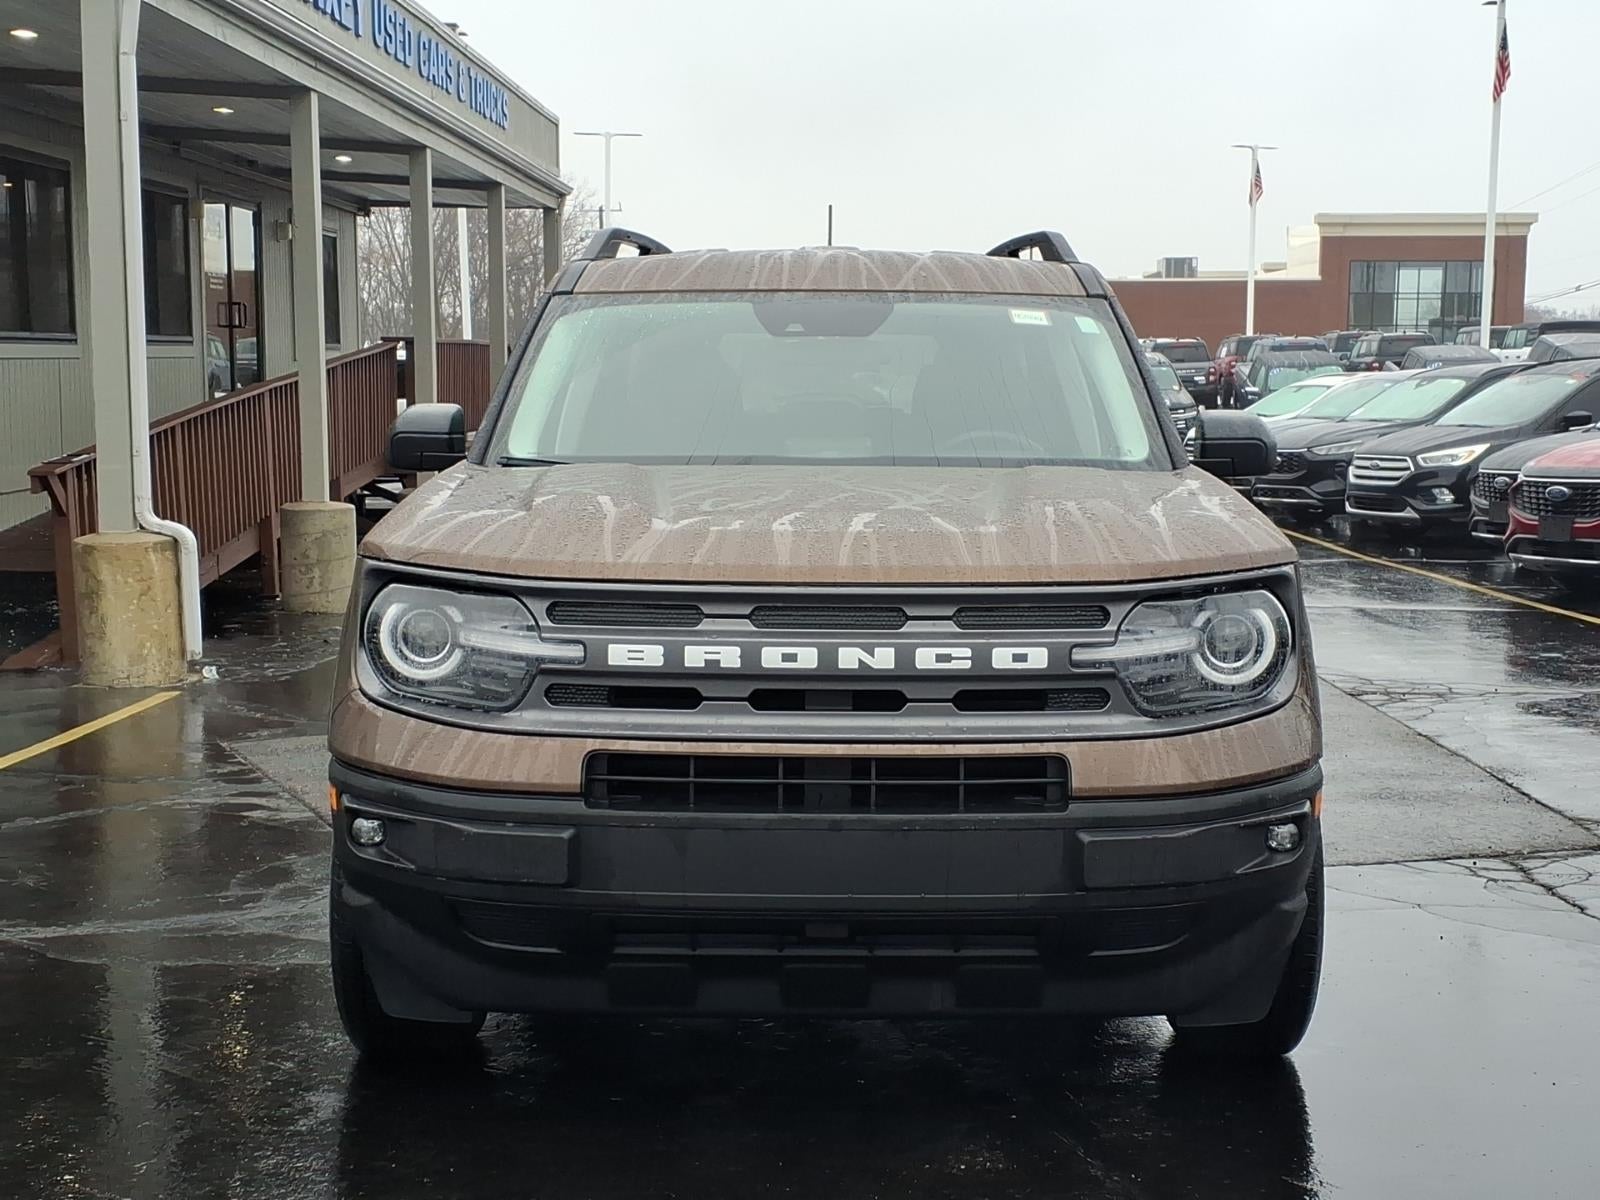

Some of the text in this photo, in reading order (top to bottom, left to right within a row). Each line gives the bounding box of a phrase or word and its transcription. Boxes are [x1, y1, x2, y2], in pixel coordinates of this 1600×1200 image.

[371, 0, 414, 68] USED
[417, 29, 454, 95] CARS
[456, 59, 467, 104] &
[467, 66, 510, 131] TRUCKS
[607, 643, 1049, 670] BRONCO
